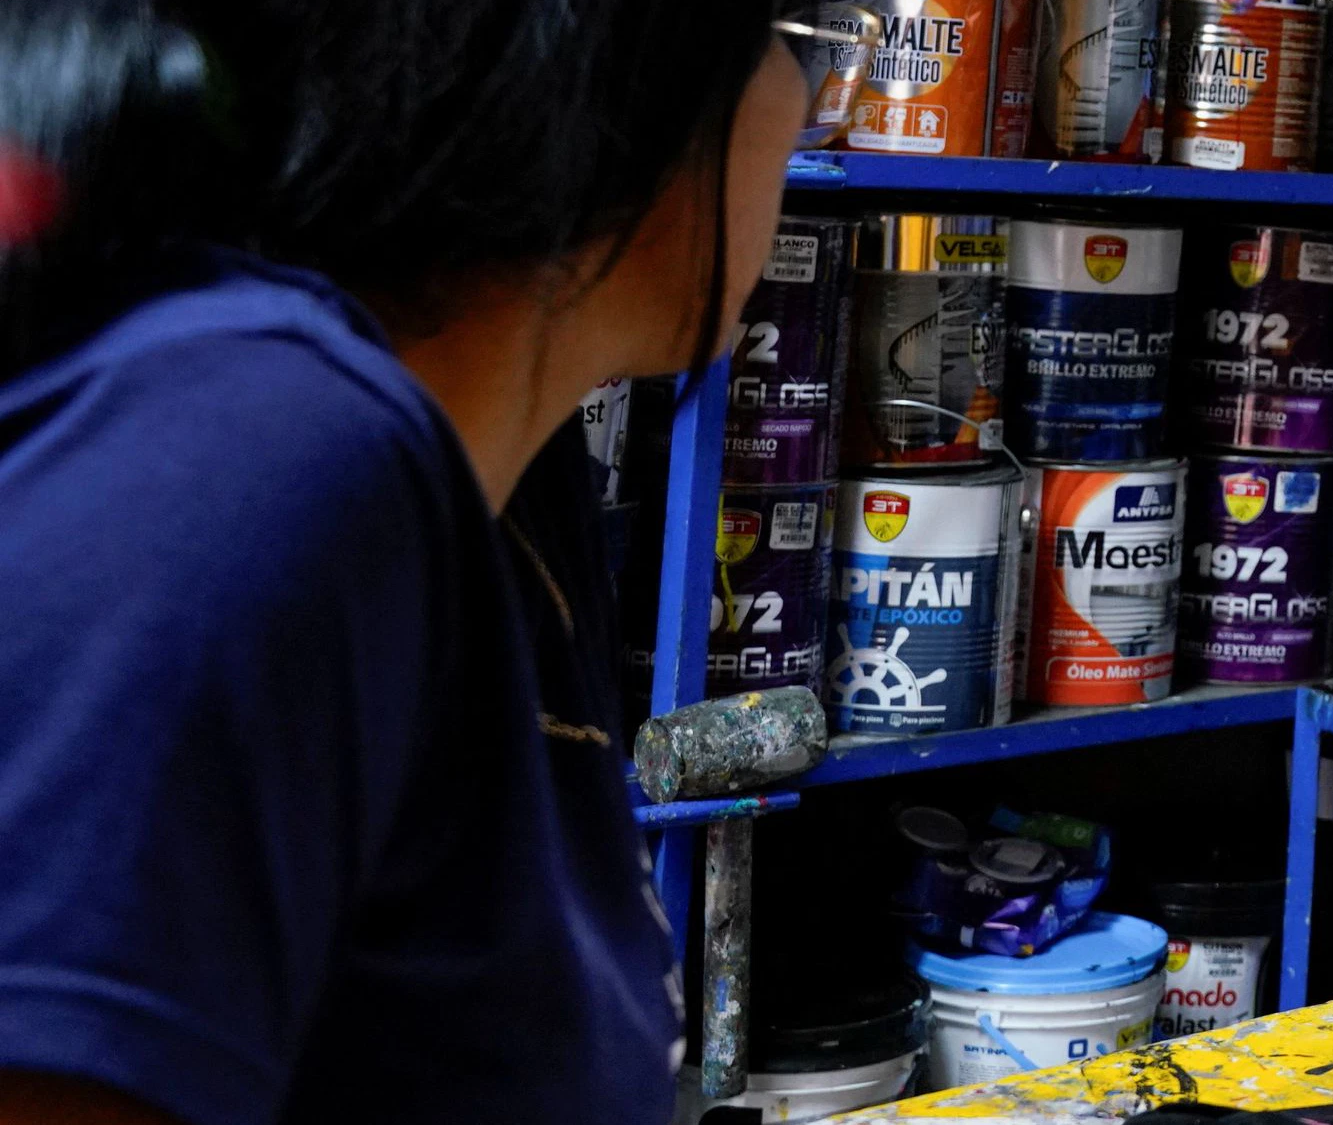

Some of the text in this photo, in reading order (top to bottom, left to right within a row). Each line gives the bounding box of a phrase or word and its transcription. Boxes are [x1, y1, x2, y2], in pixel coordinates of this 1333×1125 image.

[1204, 310, 1290, 348] 1972
[1194, 542, 1289, 583] 1972
[879, 608, 963, 626] EPÓXICO
[1231, 644, 1286, 657] EXTREMO
[1067, 663, 1141, 679] Óleo Mate
